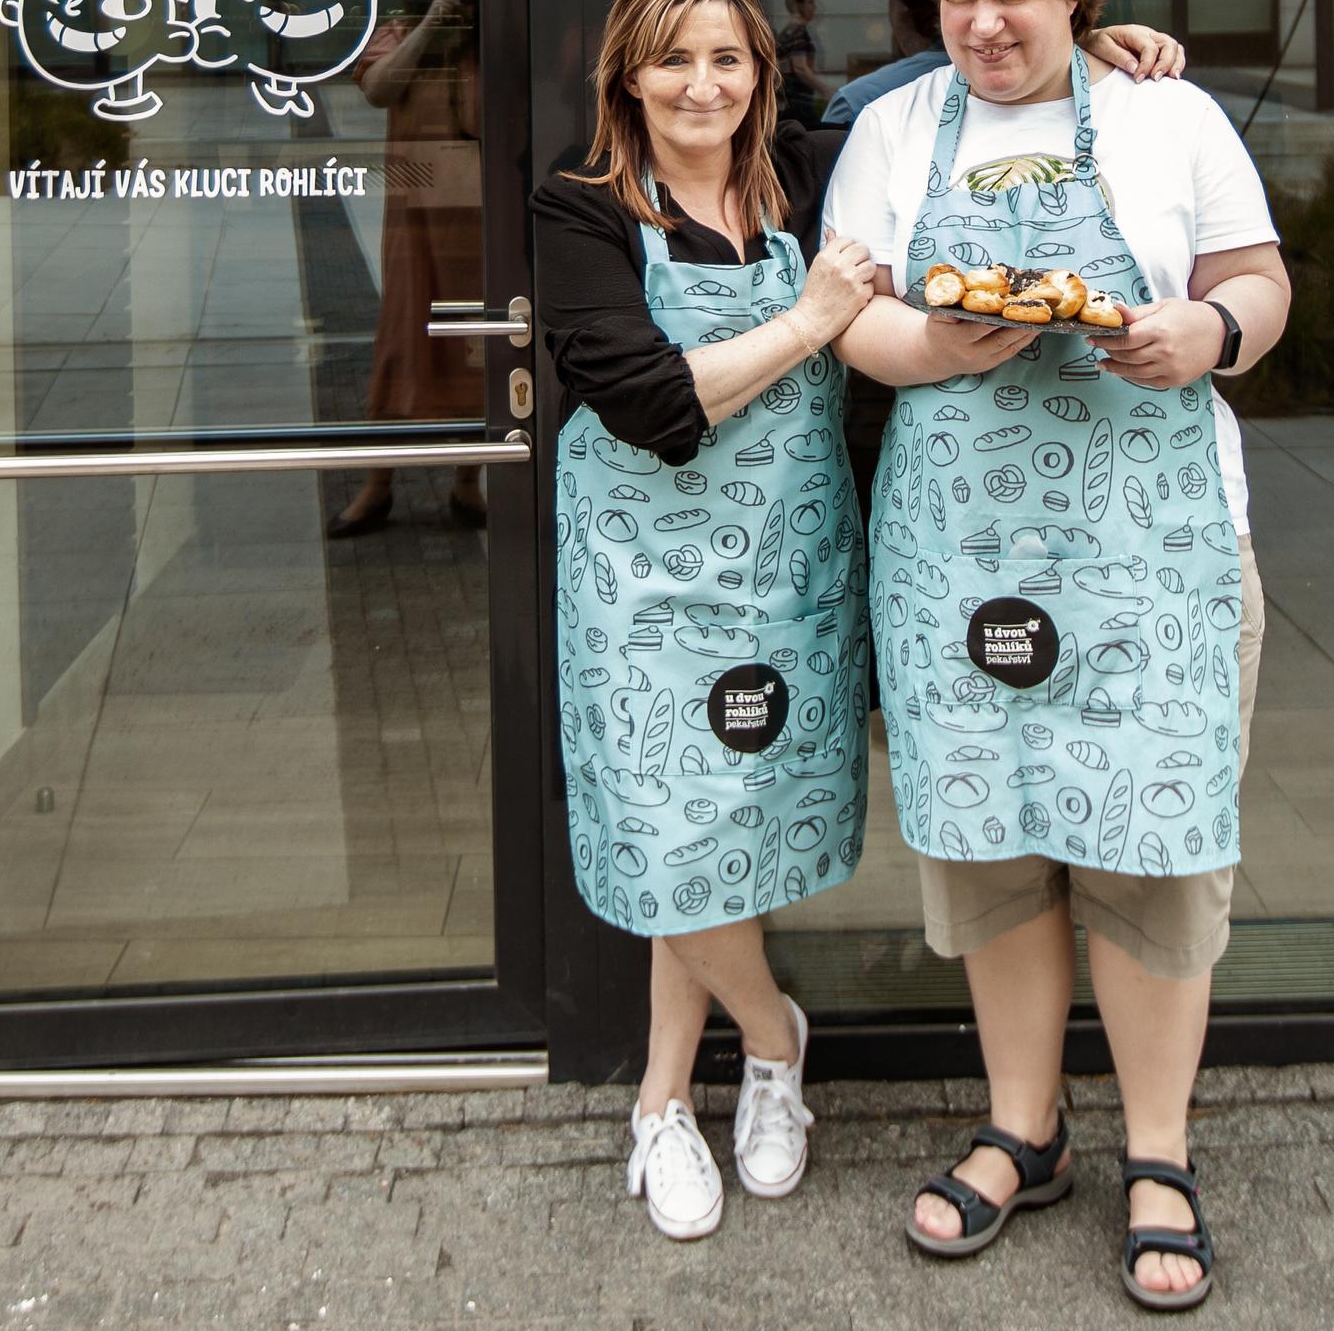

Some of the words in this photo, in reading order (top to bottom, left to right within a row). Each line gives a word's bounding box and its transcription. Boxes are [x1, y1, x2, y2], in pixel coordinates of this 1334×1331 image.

[9, 159, 107, 200] VÍTAJÍ
[115, 157, 166, 199] VÁS
[174, 167, 252, 199] KLUCI
[259, 156, 368, 198] ROHLÍCI
[984, 628, 993, 638] u
[994, 626, 1027, 638] dvou
[736, 692, 765, 703] dvou
